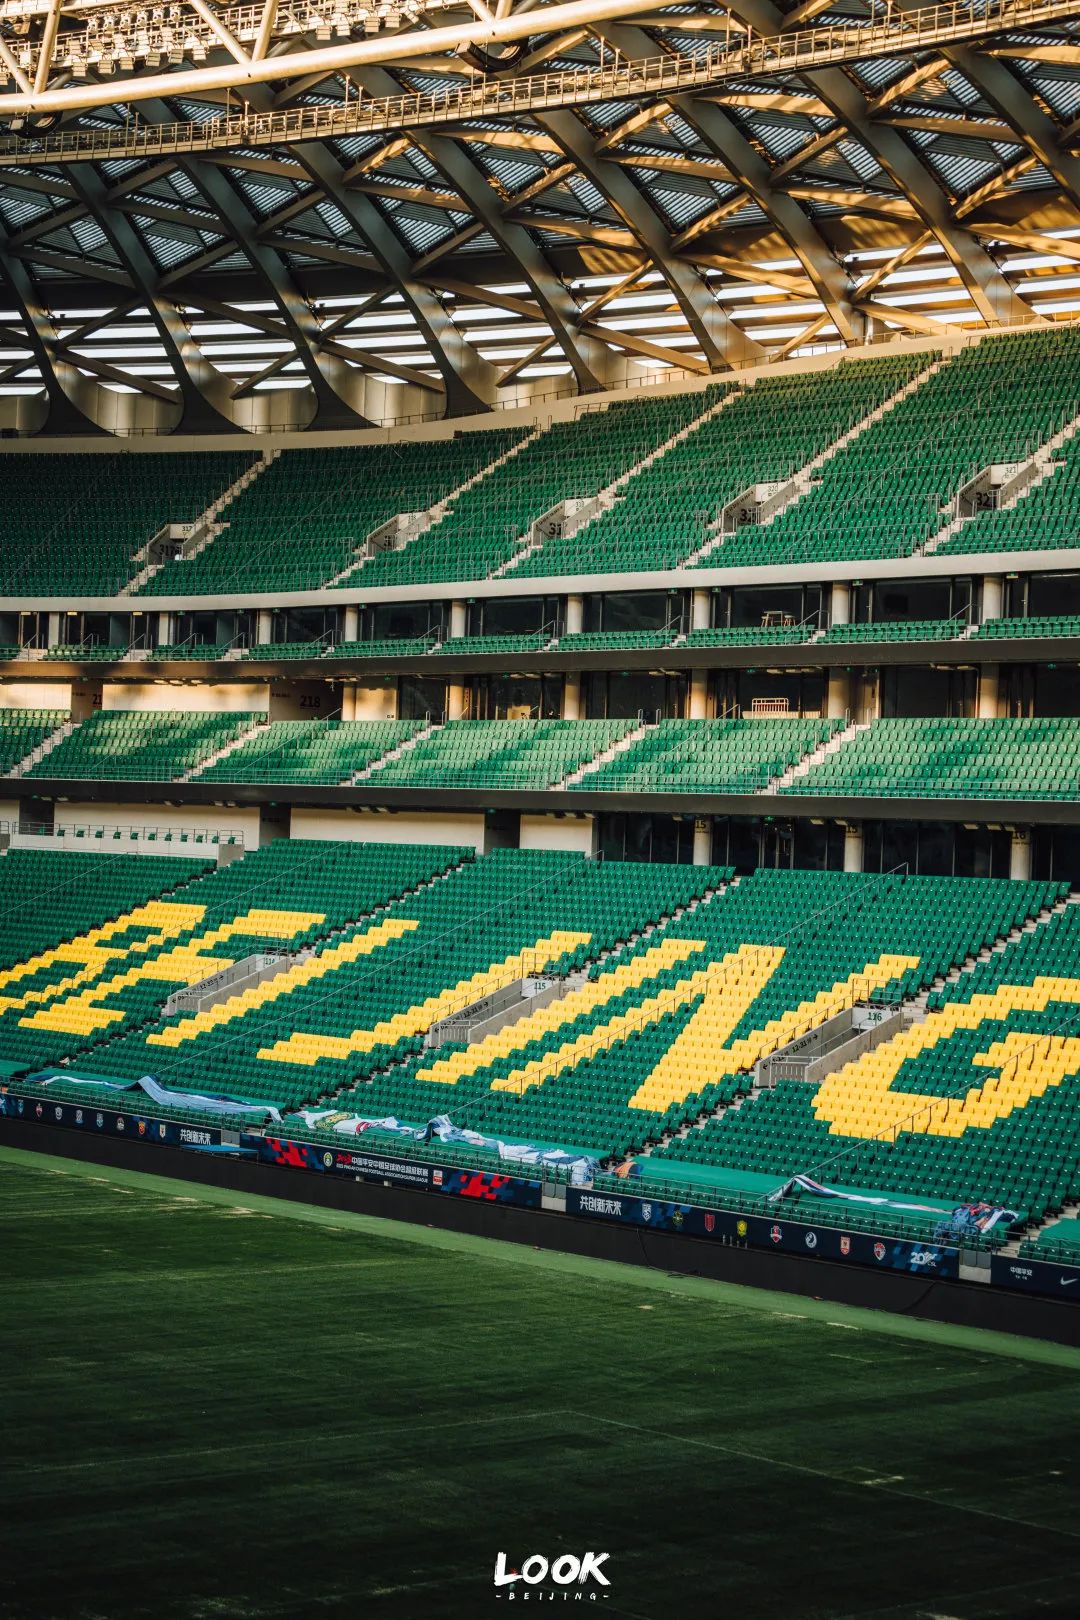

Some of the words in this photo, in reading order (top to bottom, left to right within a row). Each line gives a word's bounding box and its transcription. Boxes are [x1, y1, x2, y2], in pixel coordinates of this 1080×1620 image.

[300, 695, 321, 708] 218
[534, 982, 546, 990] 115
[868, 1011, 882, 1021] 116
[180, 1128, 211, 1145] 共创新未来
[580, 1195, 621, 1216] 共创新未来
